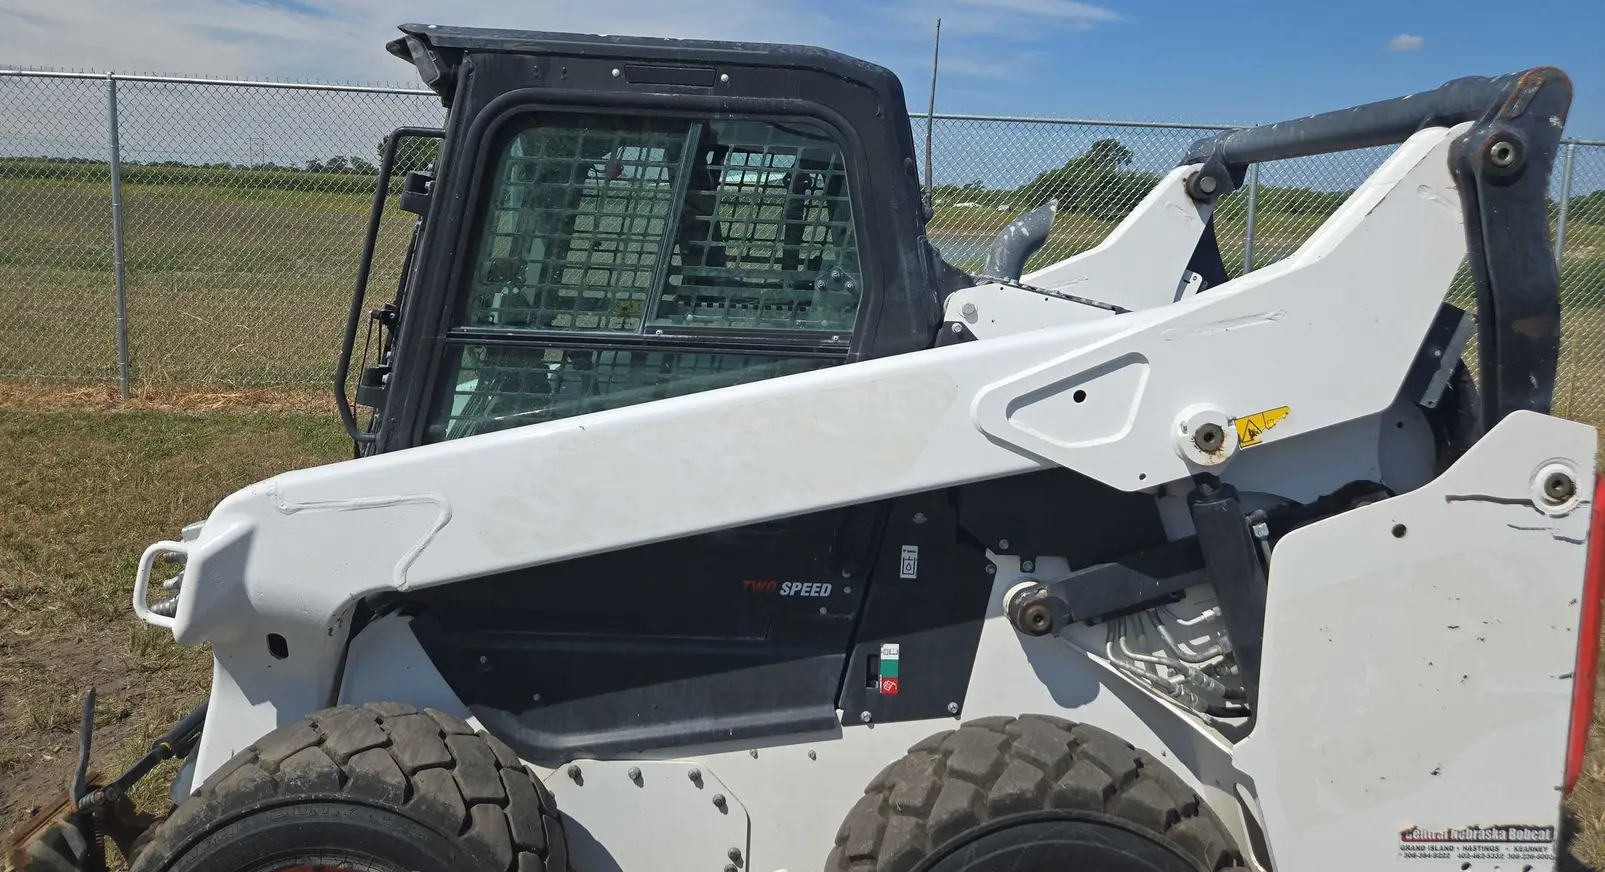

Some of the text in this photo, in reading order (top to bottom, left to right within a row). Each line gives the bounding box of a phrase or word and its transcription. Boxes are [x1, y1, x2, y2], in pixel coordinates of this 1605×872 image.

[779, 581, 832, 597] SPEED
[1450, 826, 1506, 840] Nebraska
[1508, 826, 1551, 841] Bobcat
